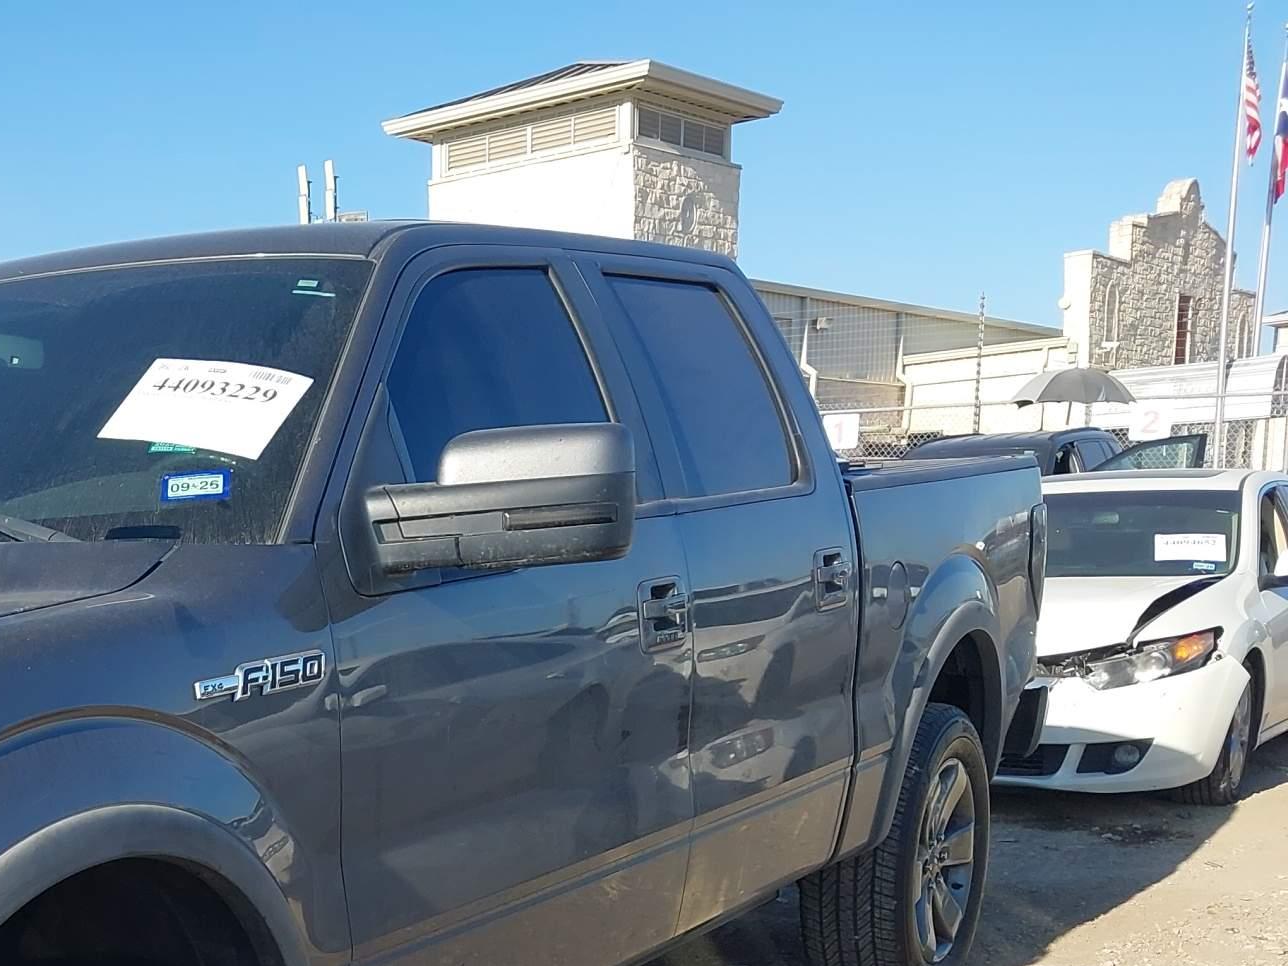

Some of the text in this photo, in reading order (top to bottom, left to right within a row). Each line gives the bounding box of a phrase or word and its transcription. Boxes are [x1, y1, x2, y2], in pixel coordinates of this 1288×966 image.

[152, 377, 278, 402] 44093229
[1142, 410, 1160, 433] 2
[203, 682, 224, 692] FX4
